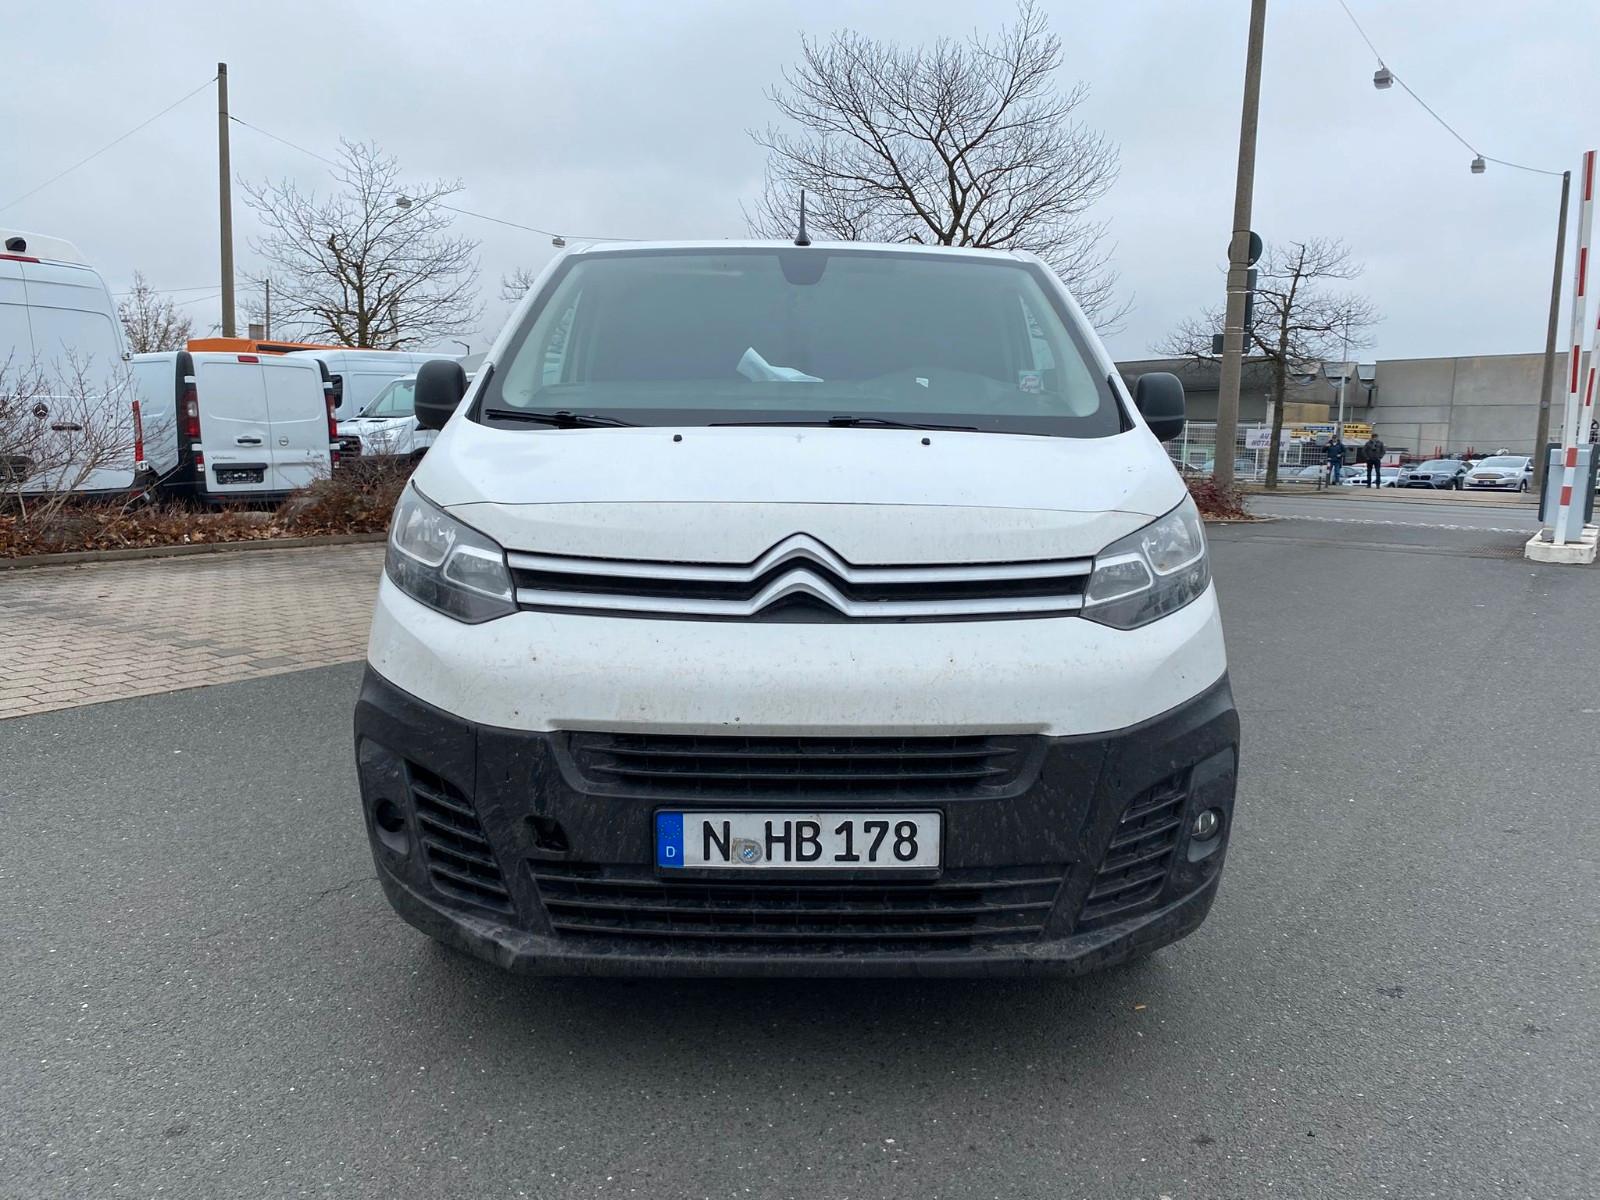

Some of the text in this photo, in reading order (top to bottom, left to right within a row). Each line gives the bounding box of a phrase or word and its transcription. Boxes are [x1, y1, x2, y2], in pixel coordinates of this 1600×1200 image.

[665, 846, 676, 858] D
[702, 820, 919, 862] N HB 178
